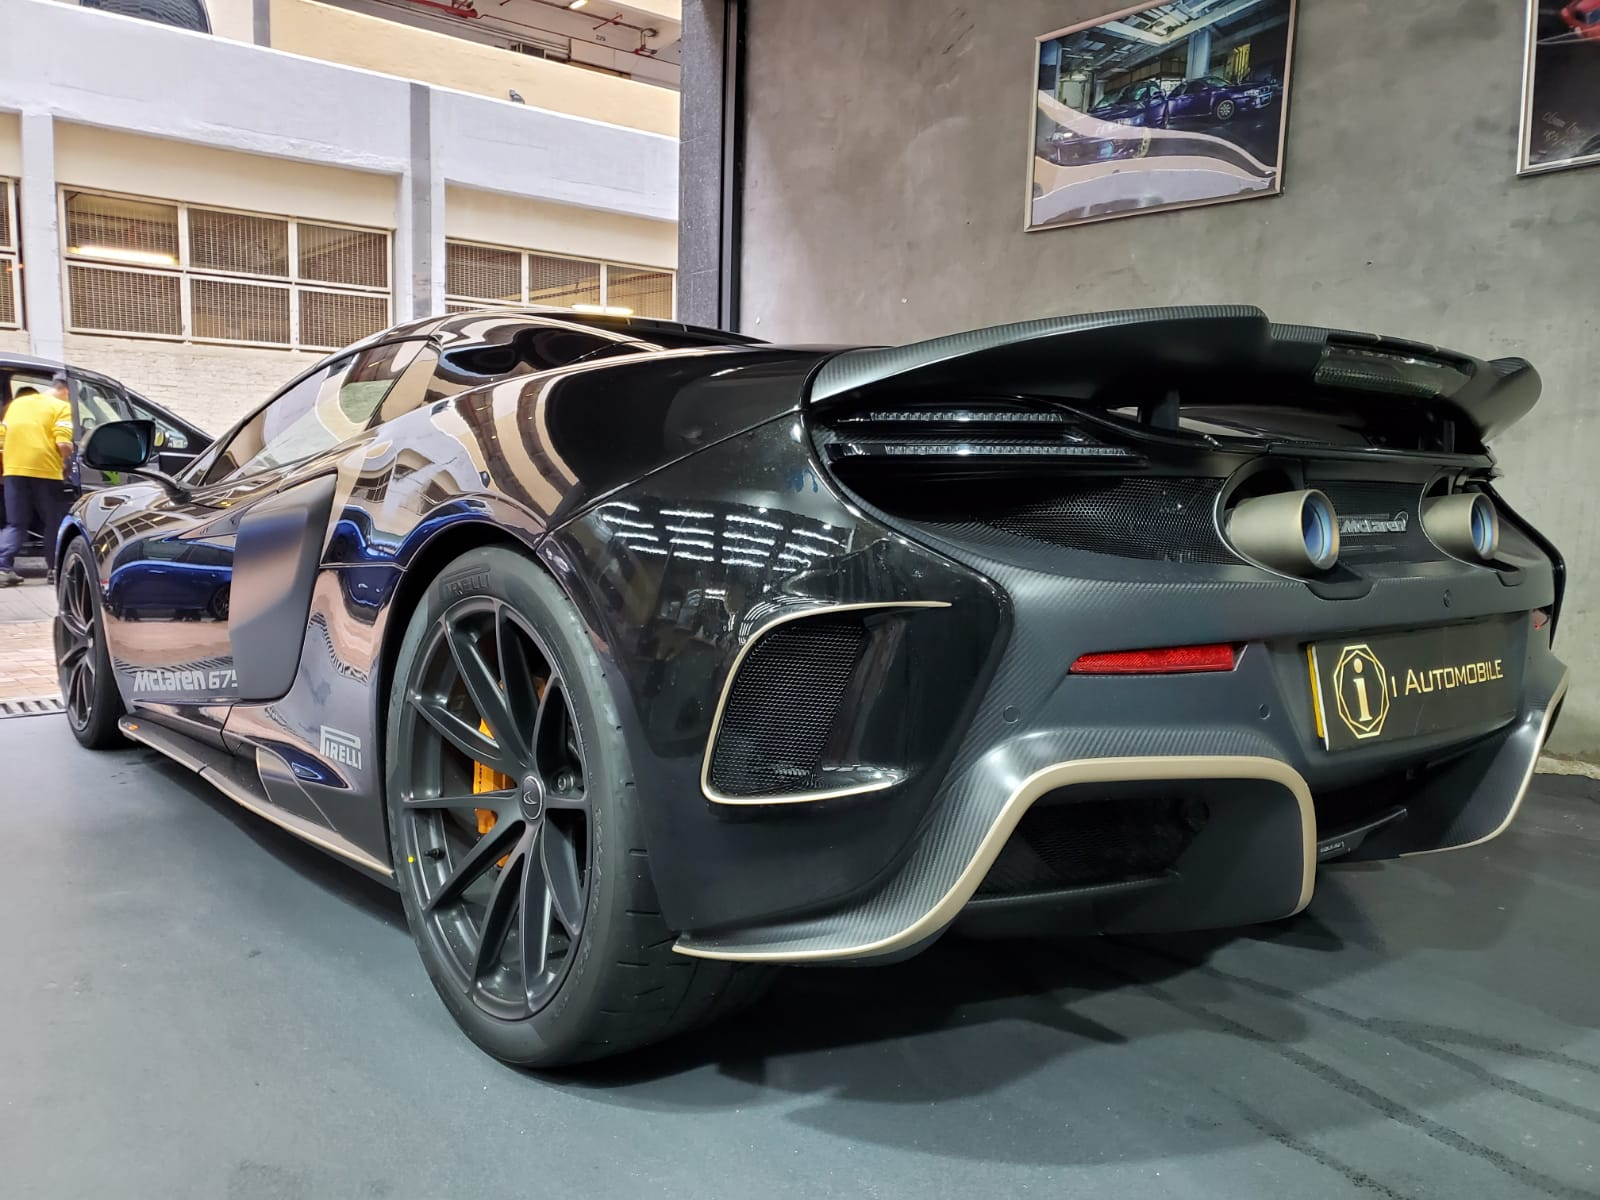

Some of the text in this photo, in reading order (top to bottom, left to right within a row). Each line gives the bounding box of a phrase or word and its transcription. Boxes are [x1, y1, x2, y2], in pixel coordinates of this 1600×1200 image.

[1340, 516, 1407, 533] McLaren
[133, 670, 206, 692] McLaren
[1405, 660, 1504, 696] AUTOMOBILE
[320, 725, 362, 770] PIRELLI
